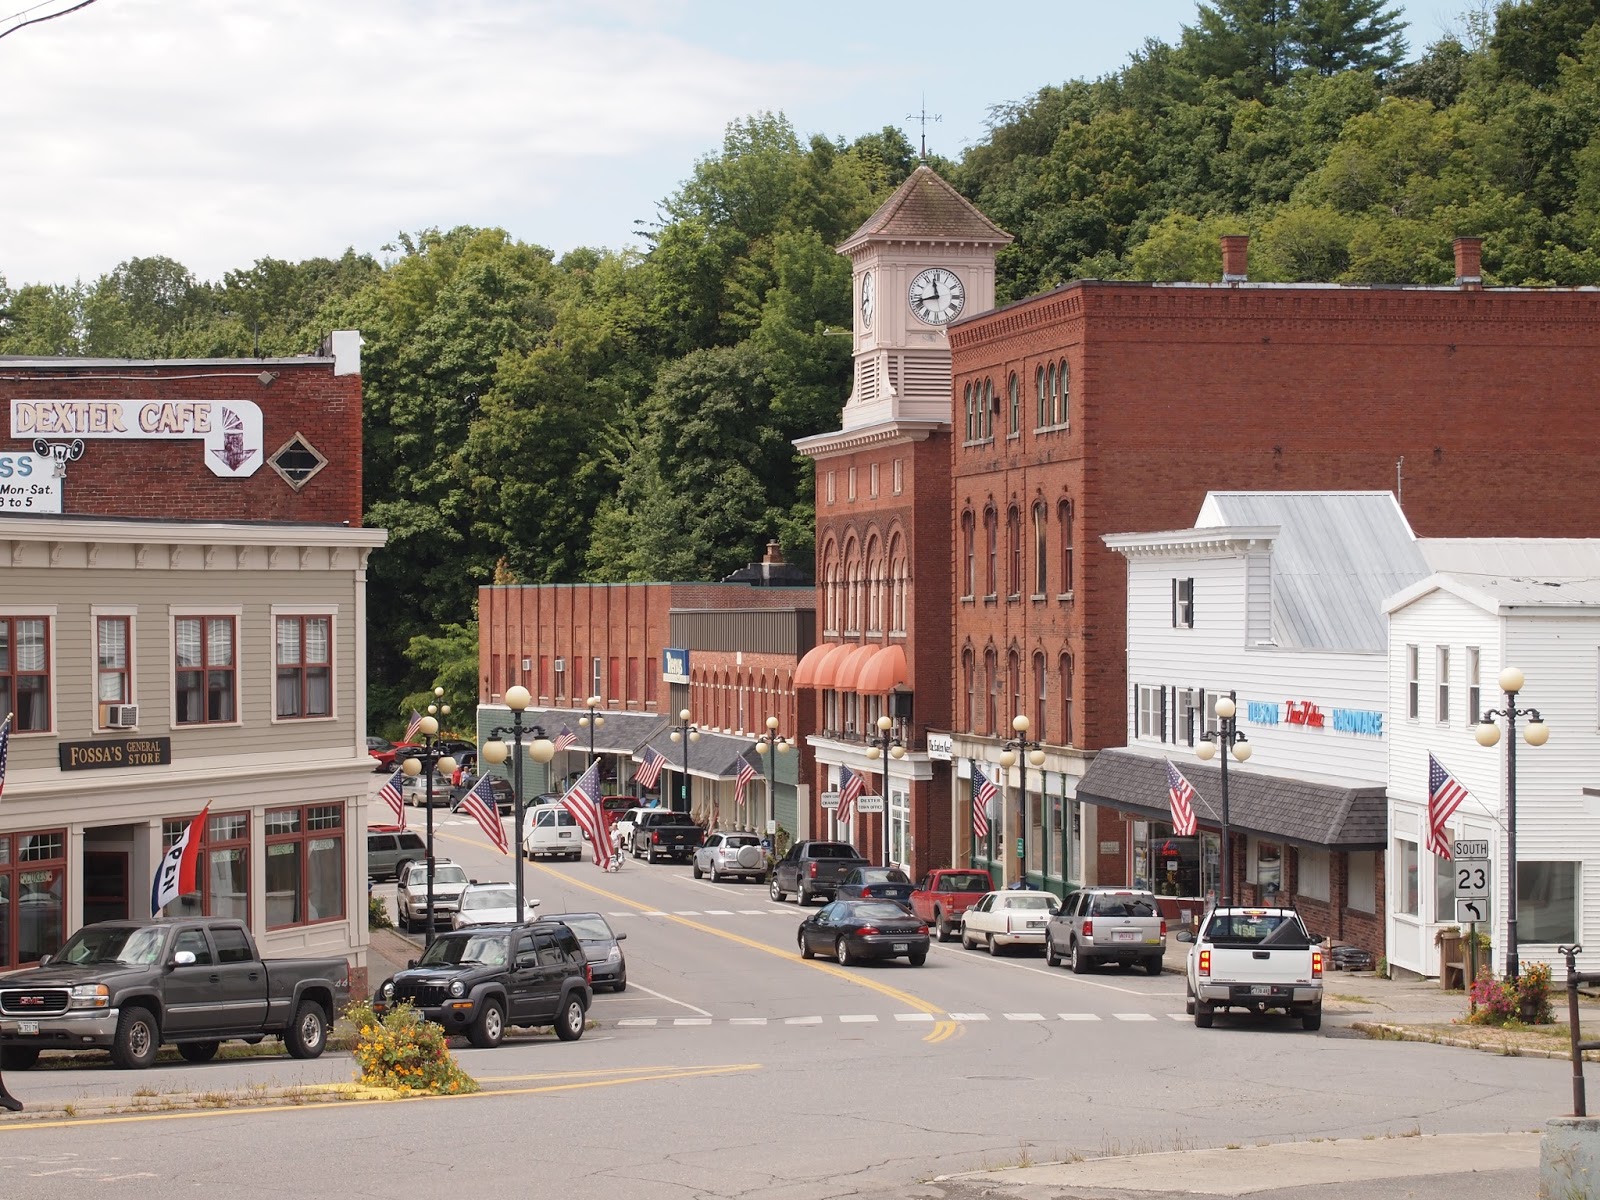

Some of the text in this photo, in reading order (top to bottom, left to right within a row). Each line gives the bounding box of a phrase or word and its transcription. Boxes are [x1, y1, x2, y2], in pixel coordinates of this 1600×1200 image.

[16, 403, 212, 433] DEXTER CAFE
[0, 484, 53, 495] Mon-Sat.
[9, 498, 22, 507] to
[25, 497, 33, 507] 5
[1333, 709, 1382, 736] HARDWARE
[126, 742, 160, 752] GENERAL
[71, 746, 122, 766] FOSSA'S
[128, 753, 160, 764] STORE
[1456, 843, 1487, 854] SOUTH
[162, 831, 184, 894] OPEN
[1458, 869, 1486, 889] 23
[20, 996, 45, 1004] GMC
